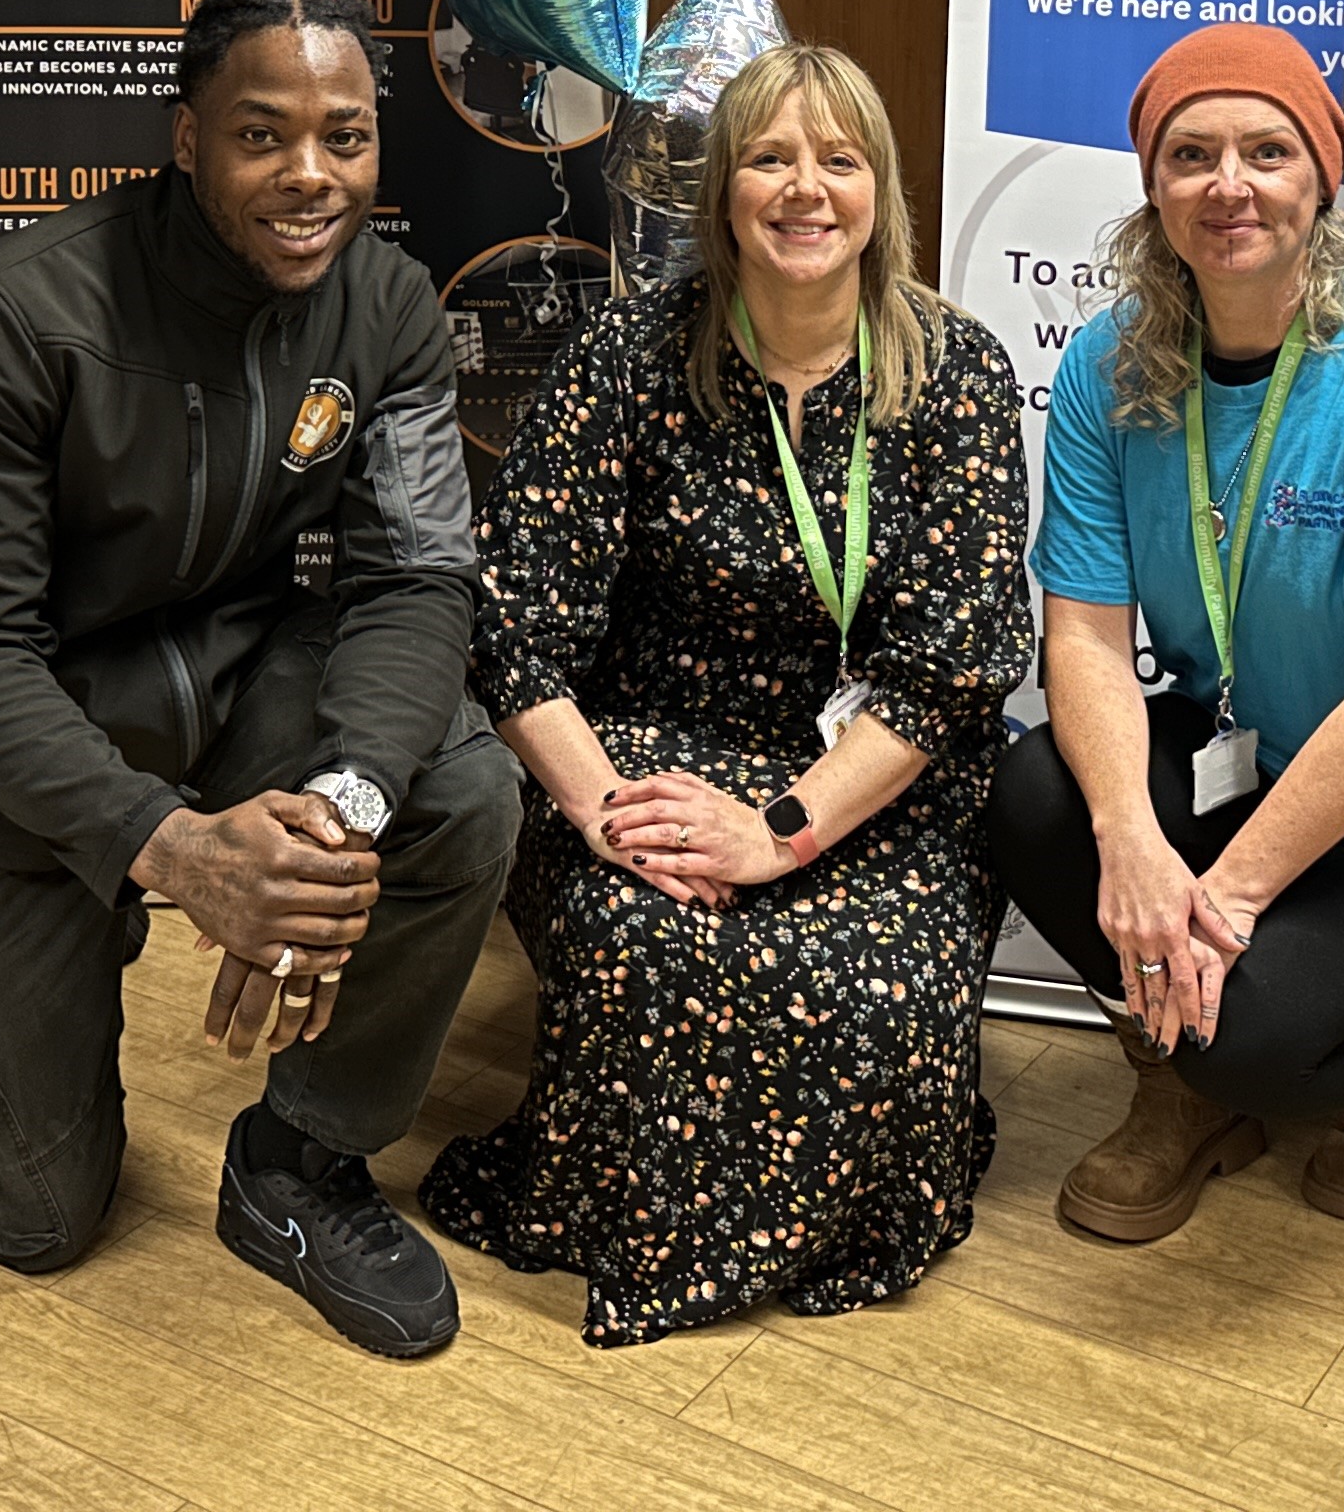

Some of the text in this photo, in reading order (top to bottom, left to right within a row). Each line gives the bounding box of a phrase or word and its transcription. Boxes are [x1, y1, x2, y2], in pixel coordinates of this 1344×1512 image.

[39, 61, 115, 74] BECOMES
[120, 62, 132, 74] A
[137, 62, 181, 74] GATE
[53, 40, 132, 52] CREATIVE
[2, 83, 108, 97] INNOVATION,
[113, 84, 147, 95] AND
[1004, 250, 1057, 286] To
[1191, 453, 1205, 512] Bloxwich
[1234, 355, 1296, 565] Bloxwich Community Partnership
[847, 472, 864, 548] Community
[1195, 515, 1217, 592] Community
